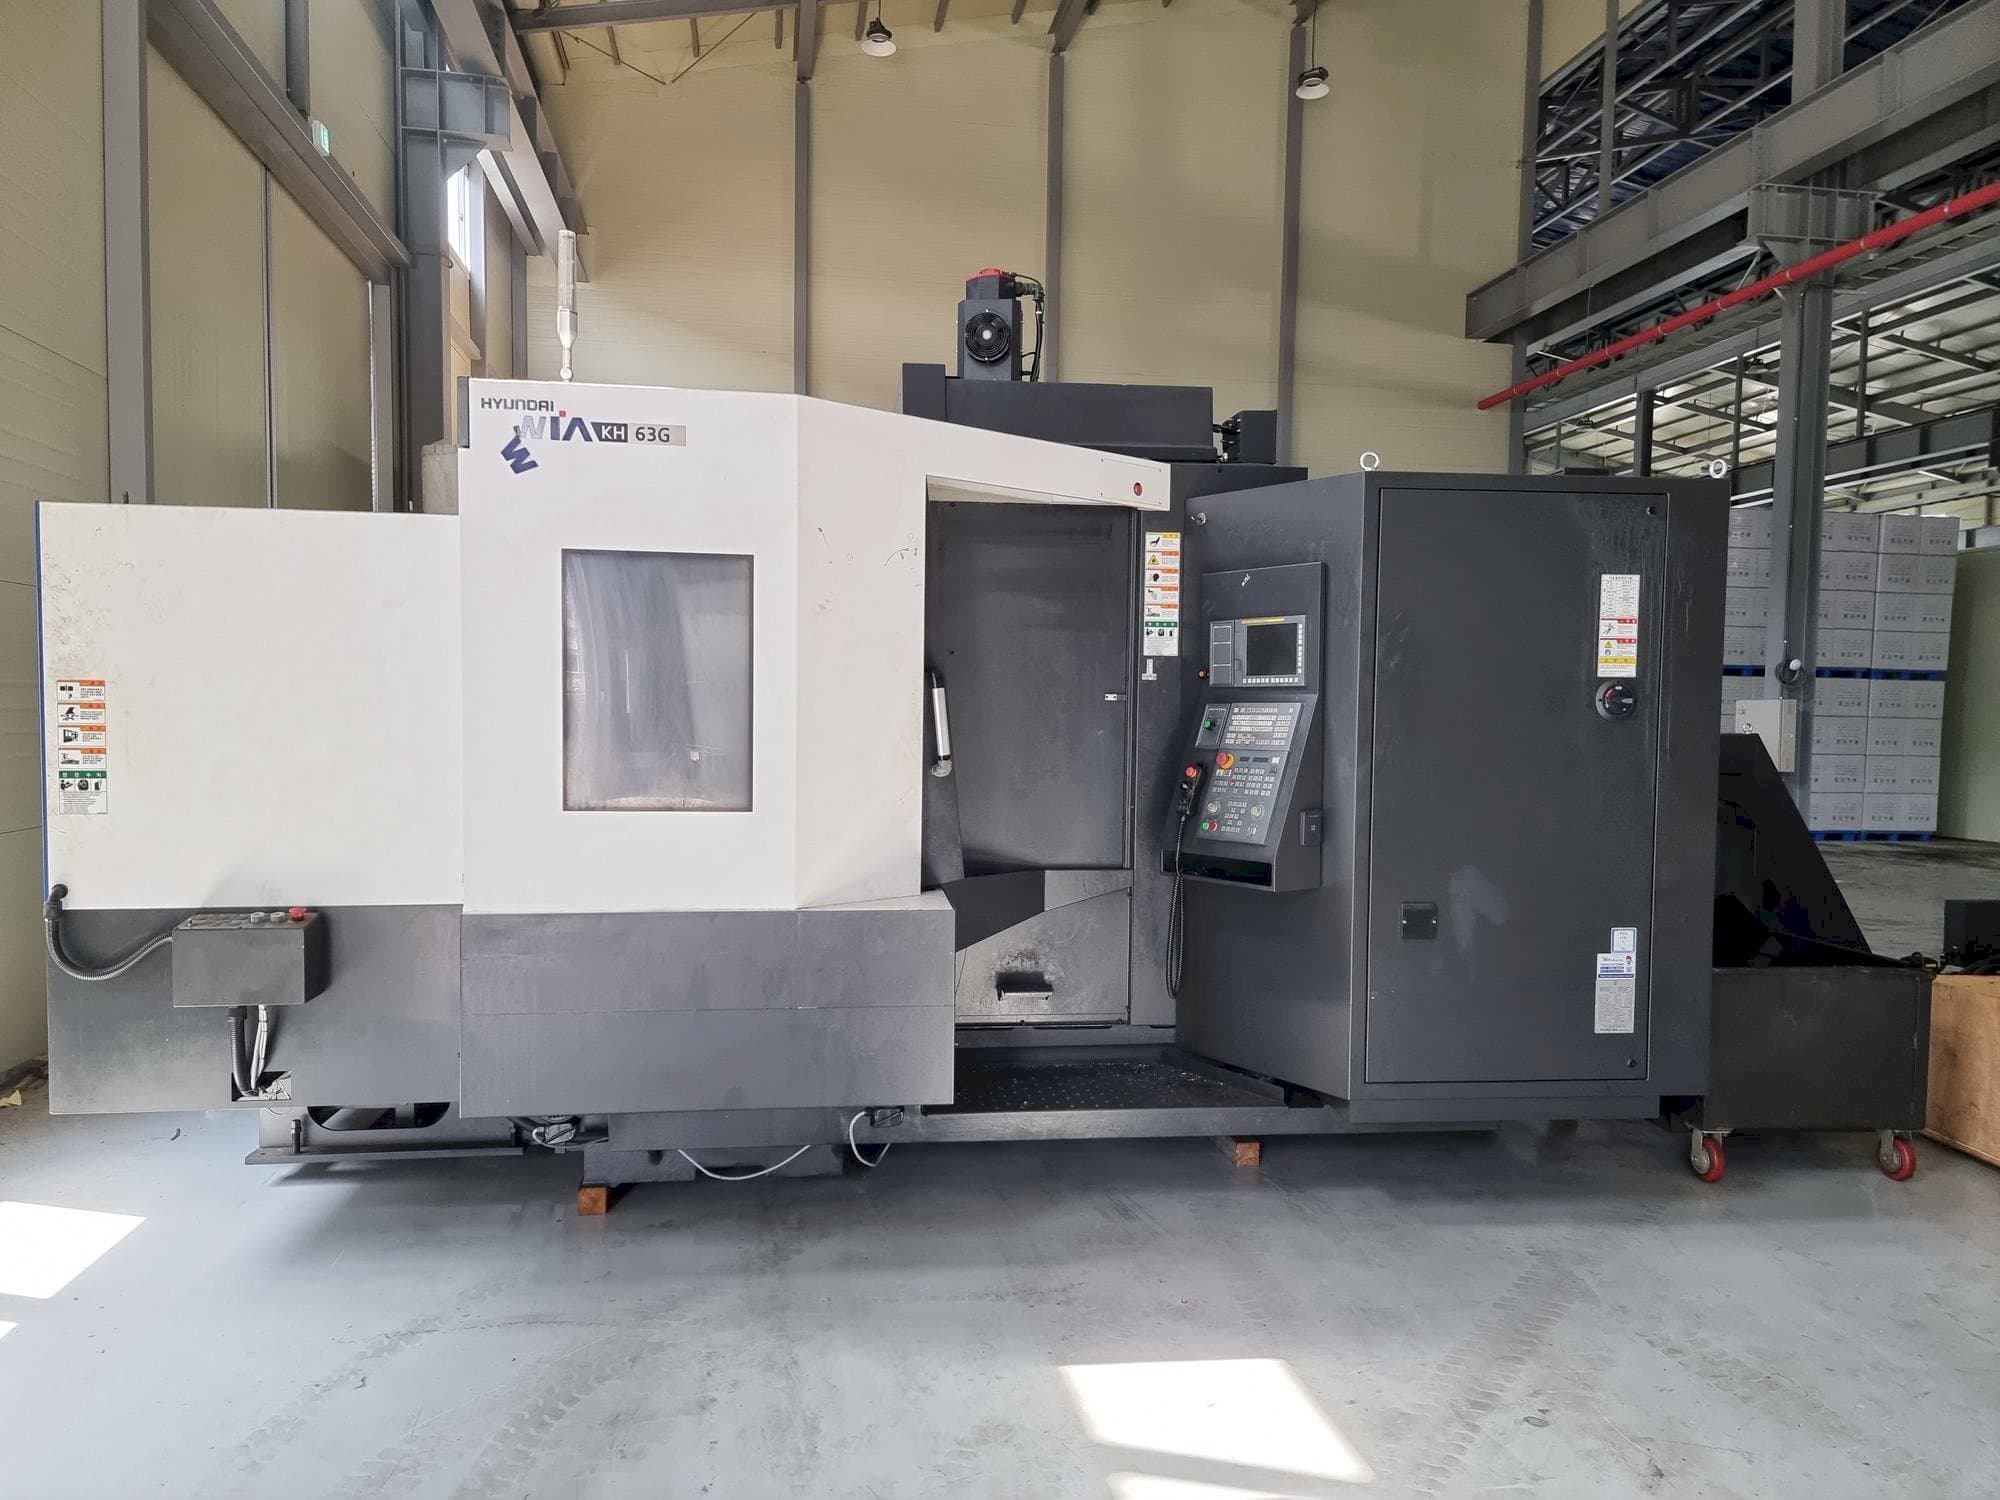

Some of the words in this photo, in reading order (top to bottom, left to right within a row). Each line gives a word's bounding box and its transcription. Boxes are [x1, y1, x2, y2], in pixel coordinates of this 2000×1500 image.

[480, 397, 554, 412] HYUNDAI
[601, 425, 626, 441] KH
[635, 426, 671, 443] 63G
